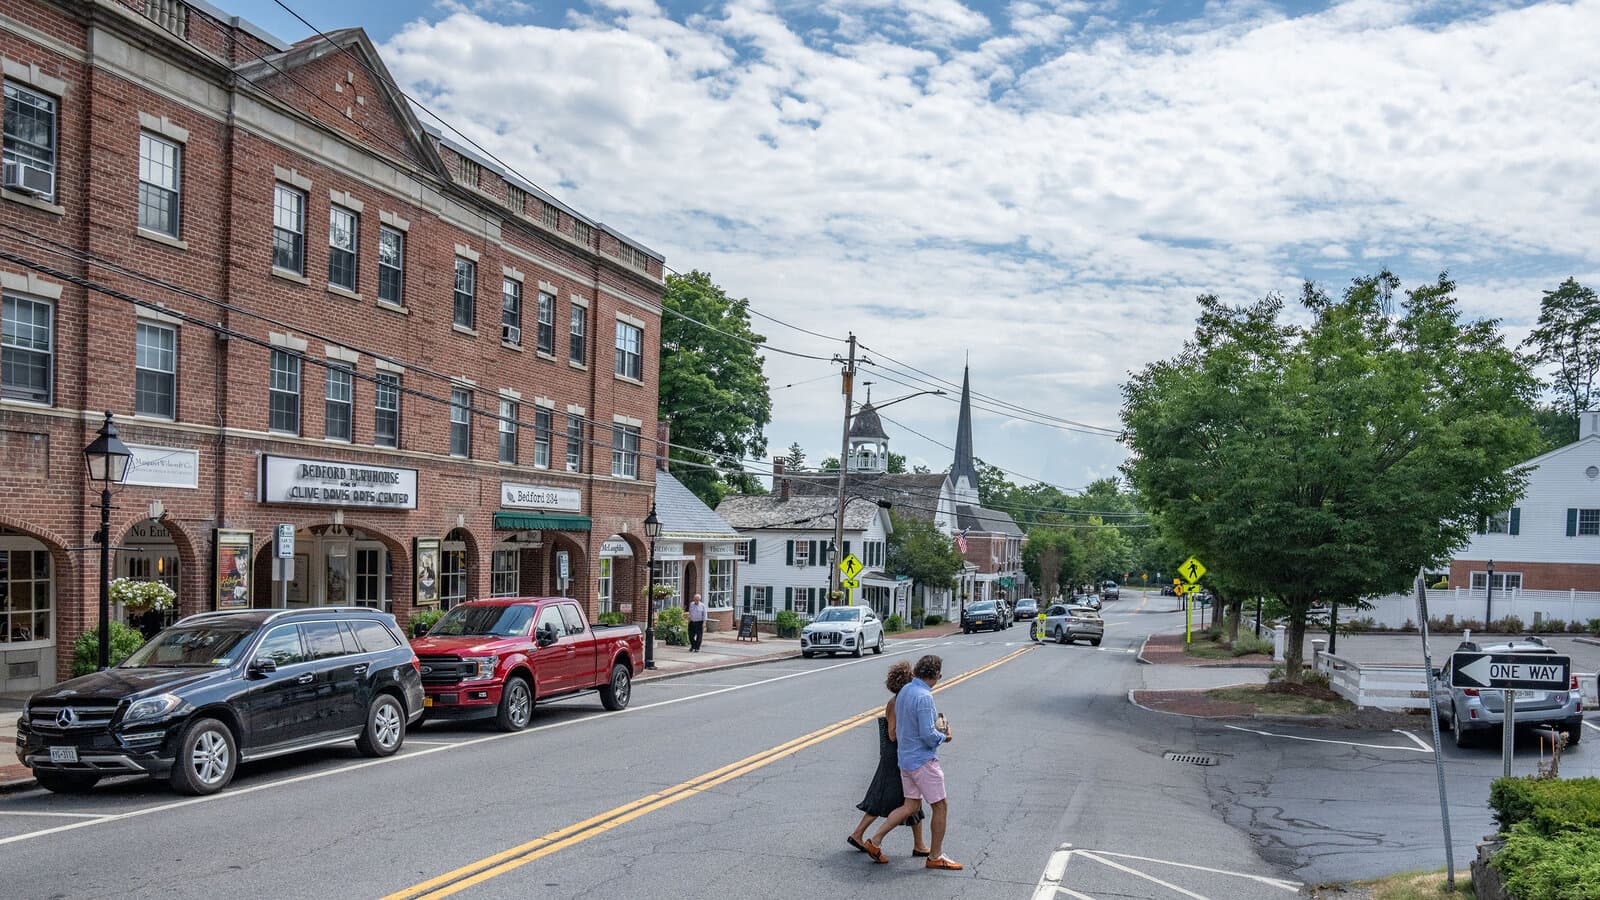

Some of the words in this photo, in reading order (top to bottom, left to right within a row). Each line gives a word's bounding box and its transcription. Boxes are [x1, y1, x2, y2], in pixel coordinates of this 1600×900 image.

[302, 464, 346, 480] BEDFORD
[350, 468, 400, 484] PLAYHOUSE
[290, 486, 320, 499] CLIVE
[323, 488, 350, 500] DAVIS
[353, 490, 376, 502] ARTS
[377, 491, 409, 504] CENTER
[517, 490, 545, 503] Bedford
[546, 493, 559, 505] 234
[131, 525, 146, 537] No
[150, 525, 171, 537] Entr
[1490, 664, 1520, 679] ONE
[1529, 666, 1558, 680] WAY
